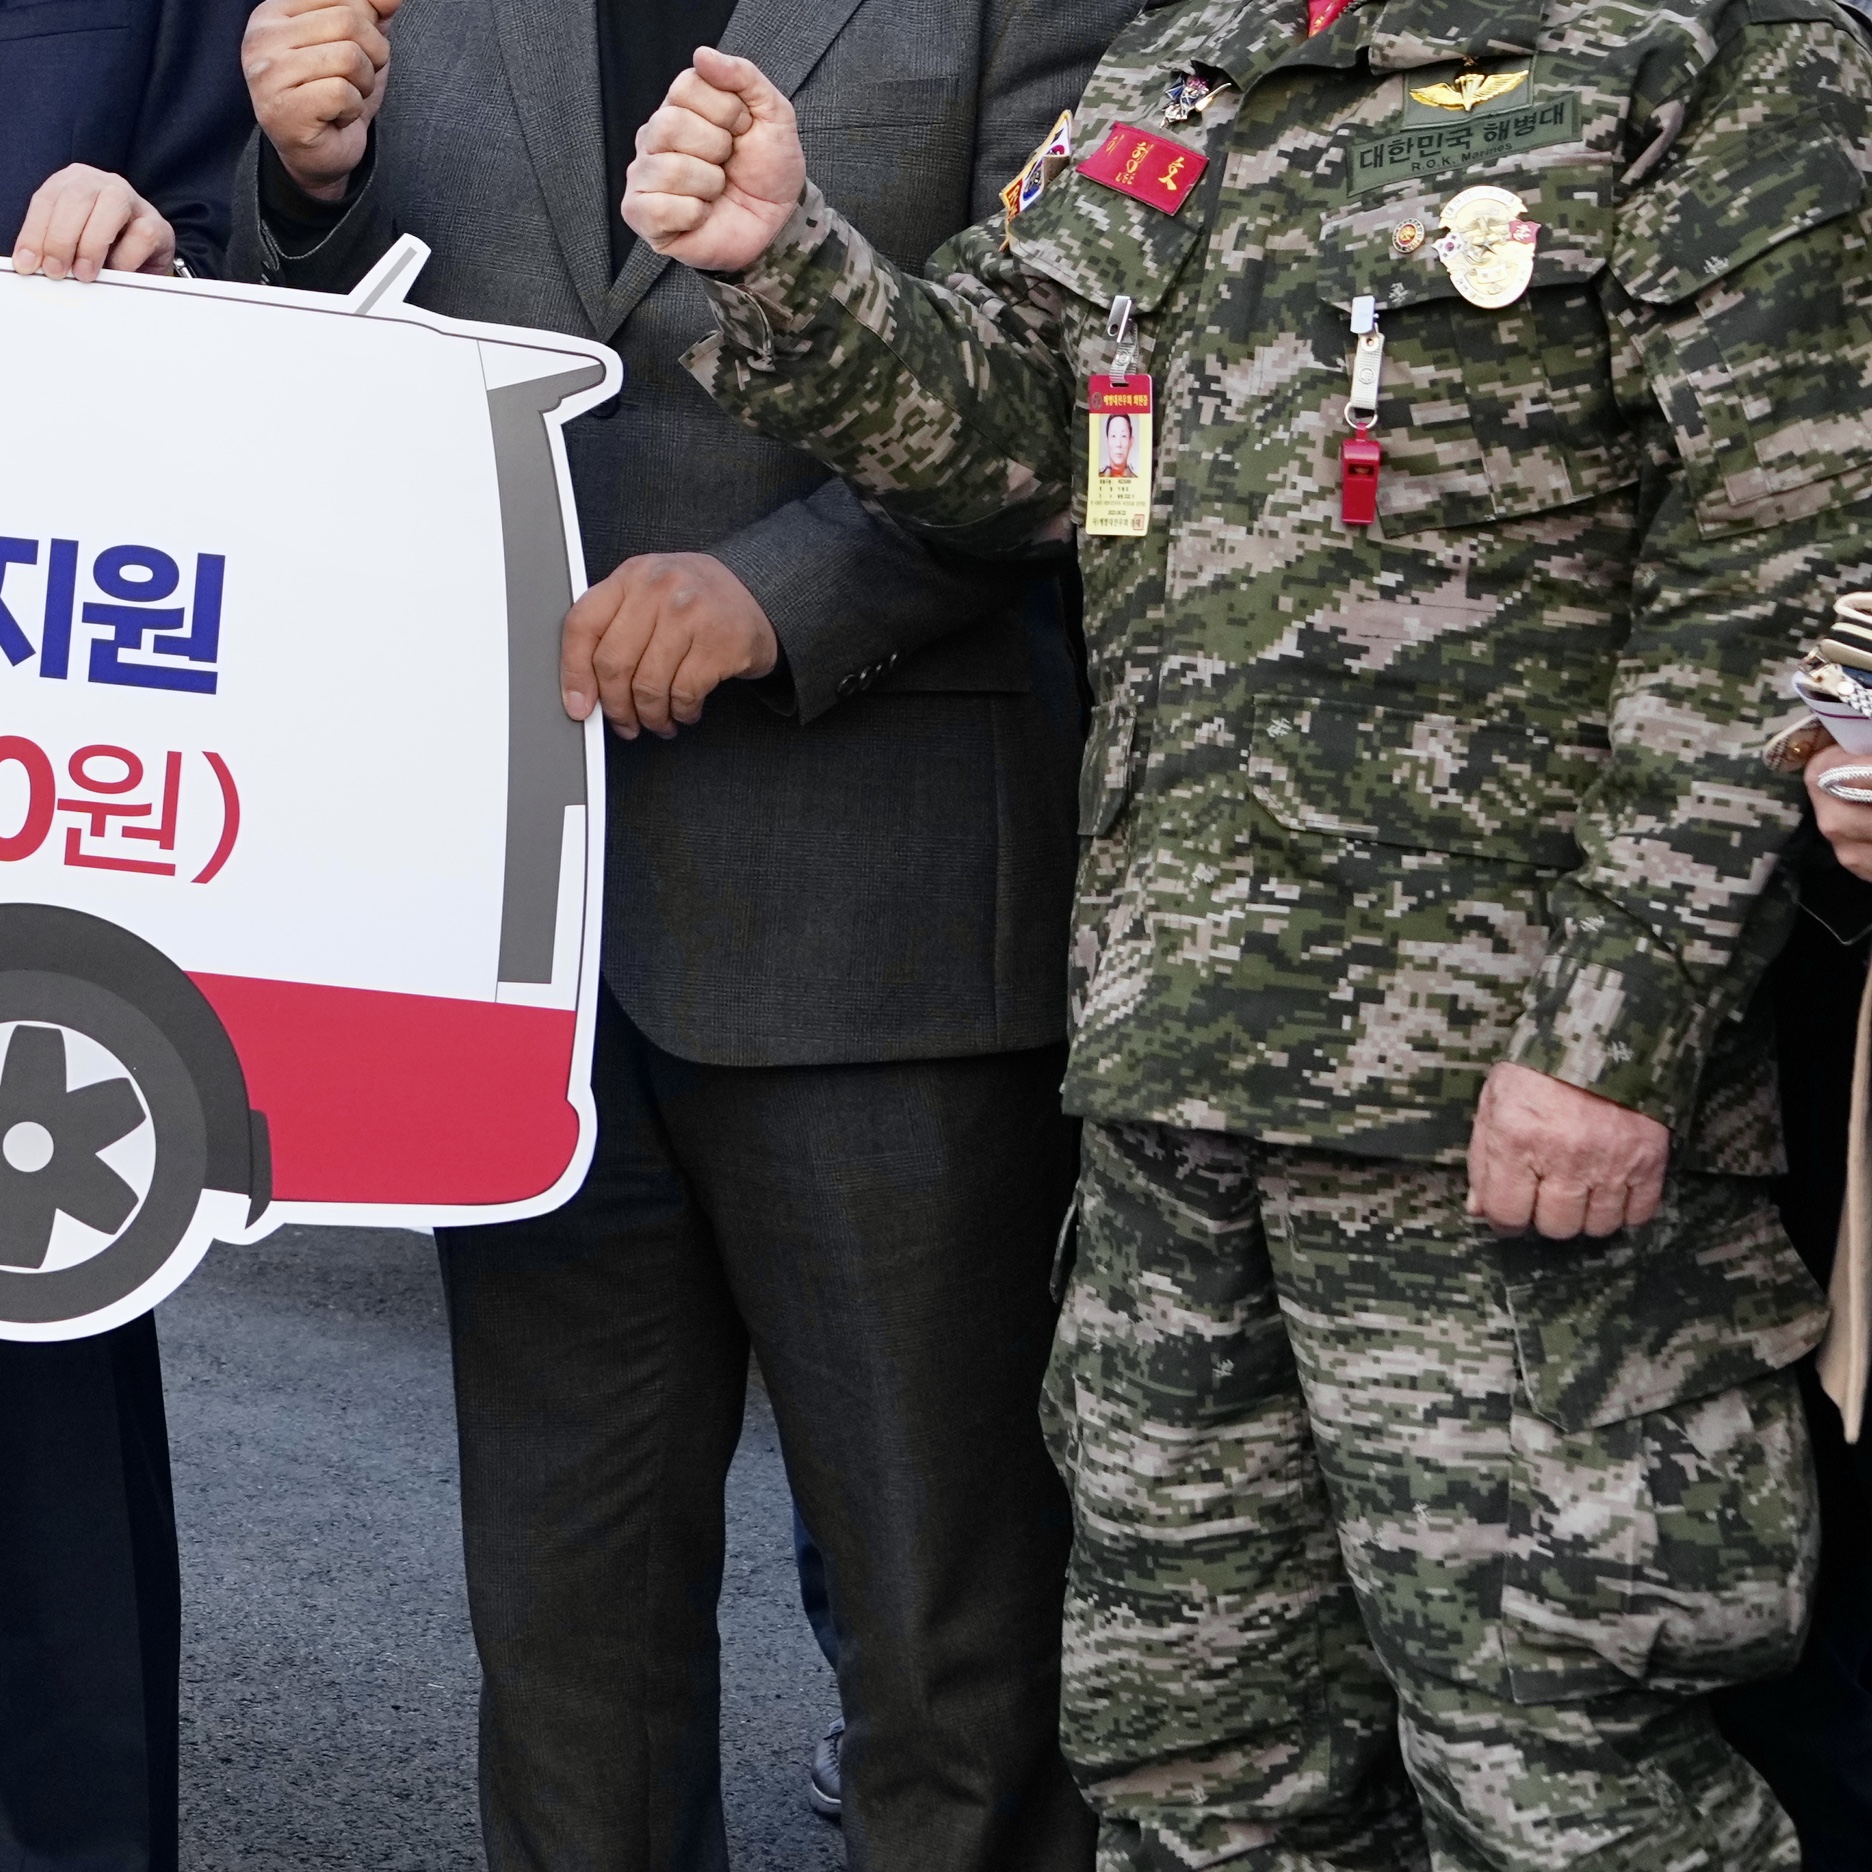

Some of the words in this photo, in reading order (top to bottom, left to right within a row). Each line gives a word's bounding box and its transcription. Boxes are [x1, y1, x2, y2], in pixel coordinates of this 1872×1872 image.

[1359, 126, 1473, 169] 대한민국
[1483, 101, 1565, 142] 해병대
[1411, 155, 1457, 172] R.O.K.
[1461, 142, 1513, 162] Marines
